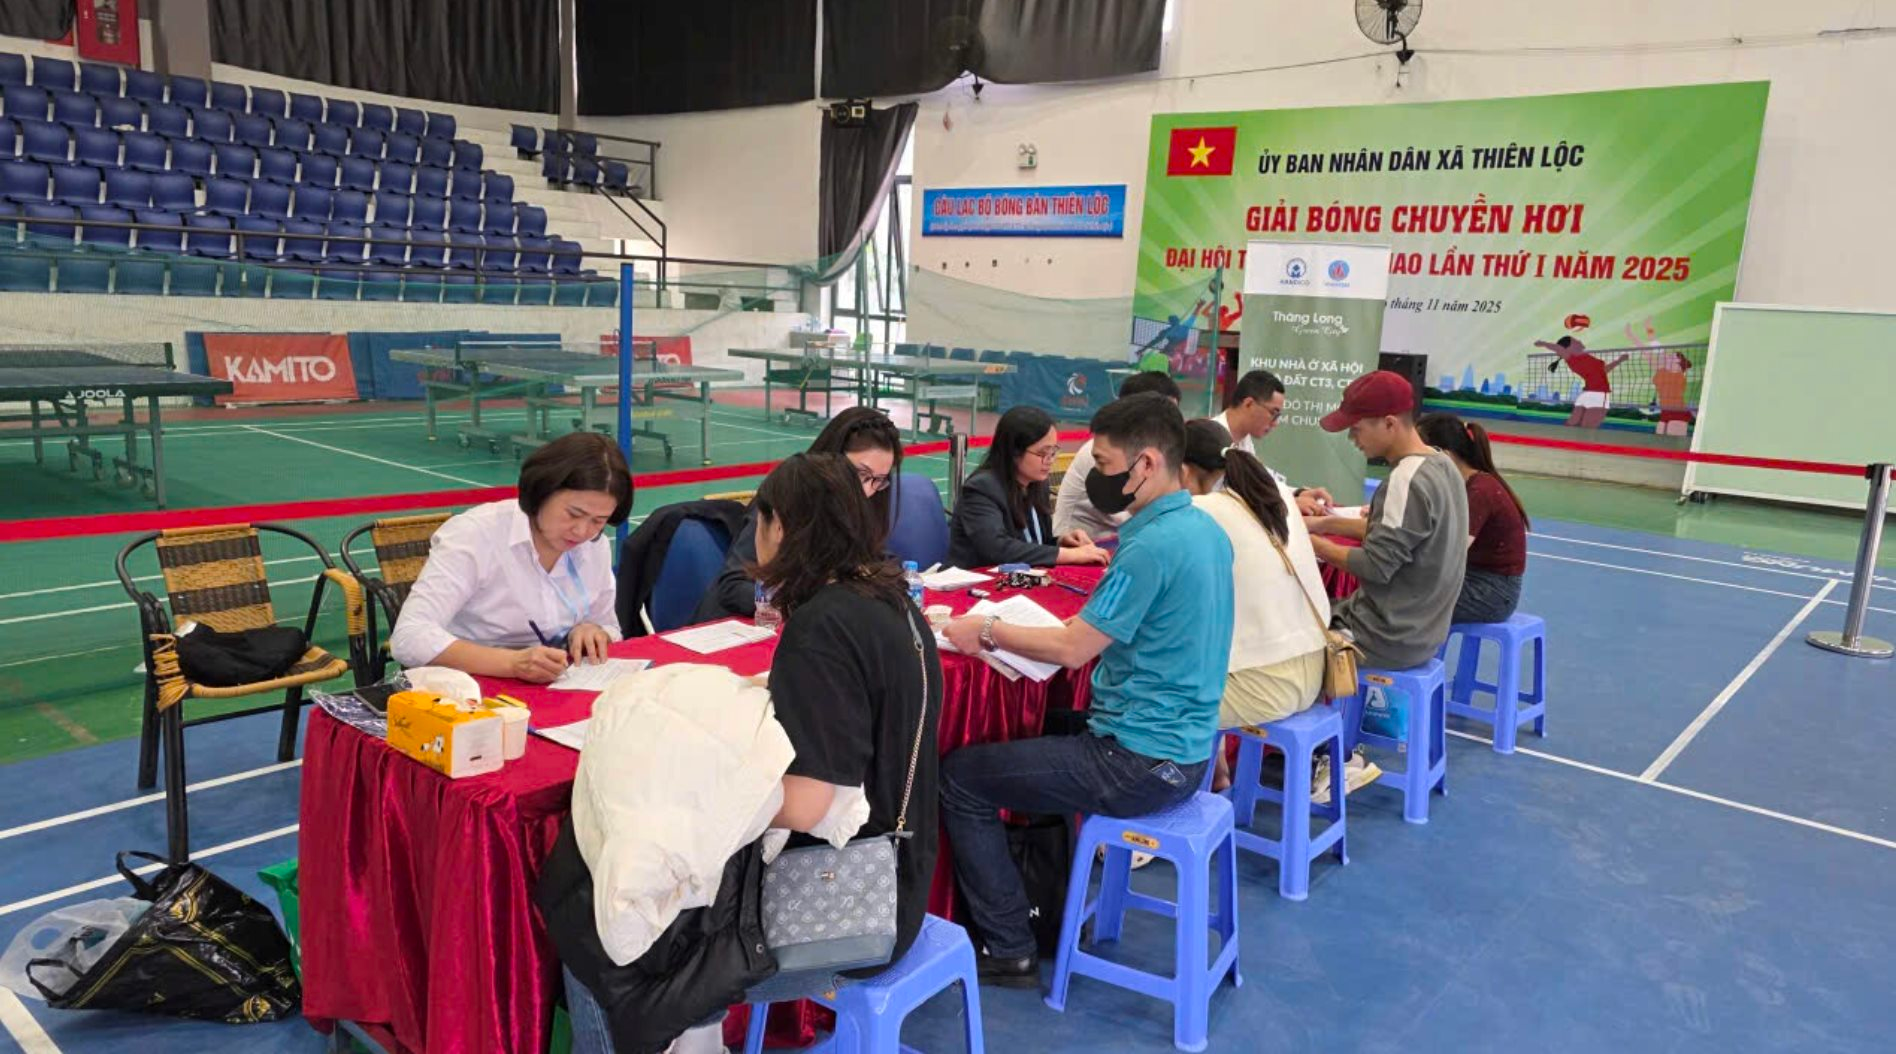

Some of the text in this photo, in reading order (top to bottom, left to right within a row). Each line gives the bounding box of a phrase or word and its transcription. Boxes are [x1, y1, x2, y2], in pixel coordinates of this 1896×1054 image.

[1258, 141, 1585, 174] ỦY BAN NHÂN DÂN XÃ THIÊN LỘC
[1245, 193, 1585, 234] GIẢI BÓNG CHUYỀN HƠI
[1165, 247, 1196, 272] ĐẠI
[1428, 245, 1474, 276] LẦN
[1482, 250, 1531, 278] THỨ
[1534, 253, 1548, 278] I
[1553, 250, 1615, 280] NĂM
[1622, 256, 1690, 281] 2025
[1390, 297, 1424, 313] tháng
[1426, 298, 1440, 310] 11
[1442, 299, 1469, 312] năm
[1472, 300, 1502, 313] 2025
[1313, 312, 1343, 326] Long
[224, 355, 336, 383] KAMITO
[1250, 357, 1277, 369] KHU
[1279, 356, 1306, 370] NHÀ
[1321, 360, 1338, 372] XÃ
[1340, 361, 1364, 375] HỘI
[1283, 373, 1308, 386] ĐẤT
[1309, 377, 1335, 389] CT3,
[77, 389, 126, 399] JOOLA
[1291, 415, 1320, 426] CHU
